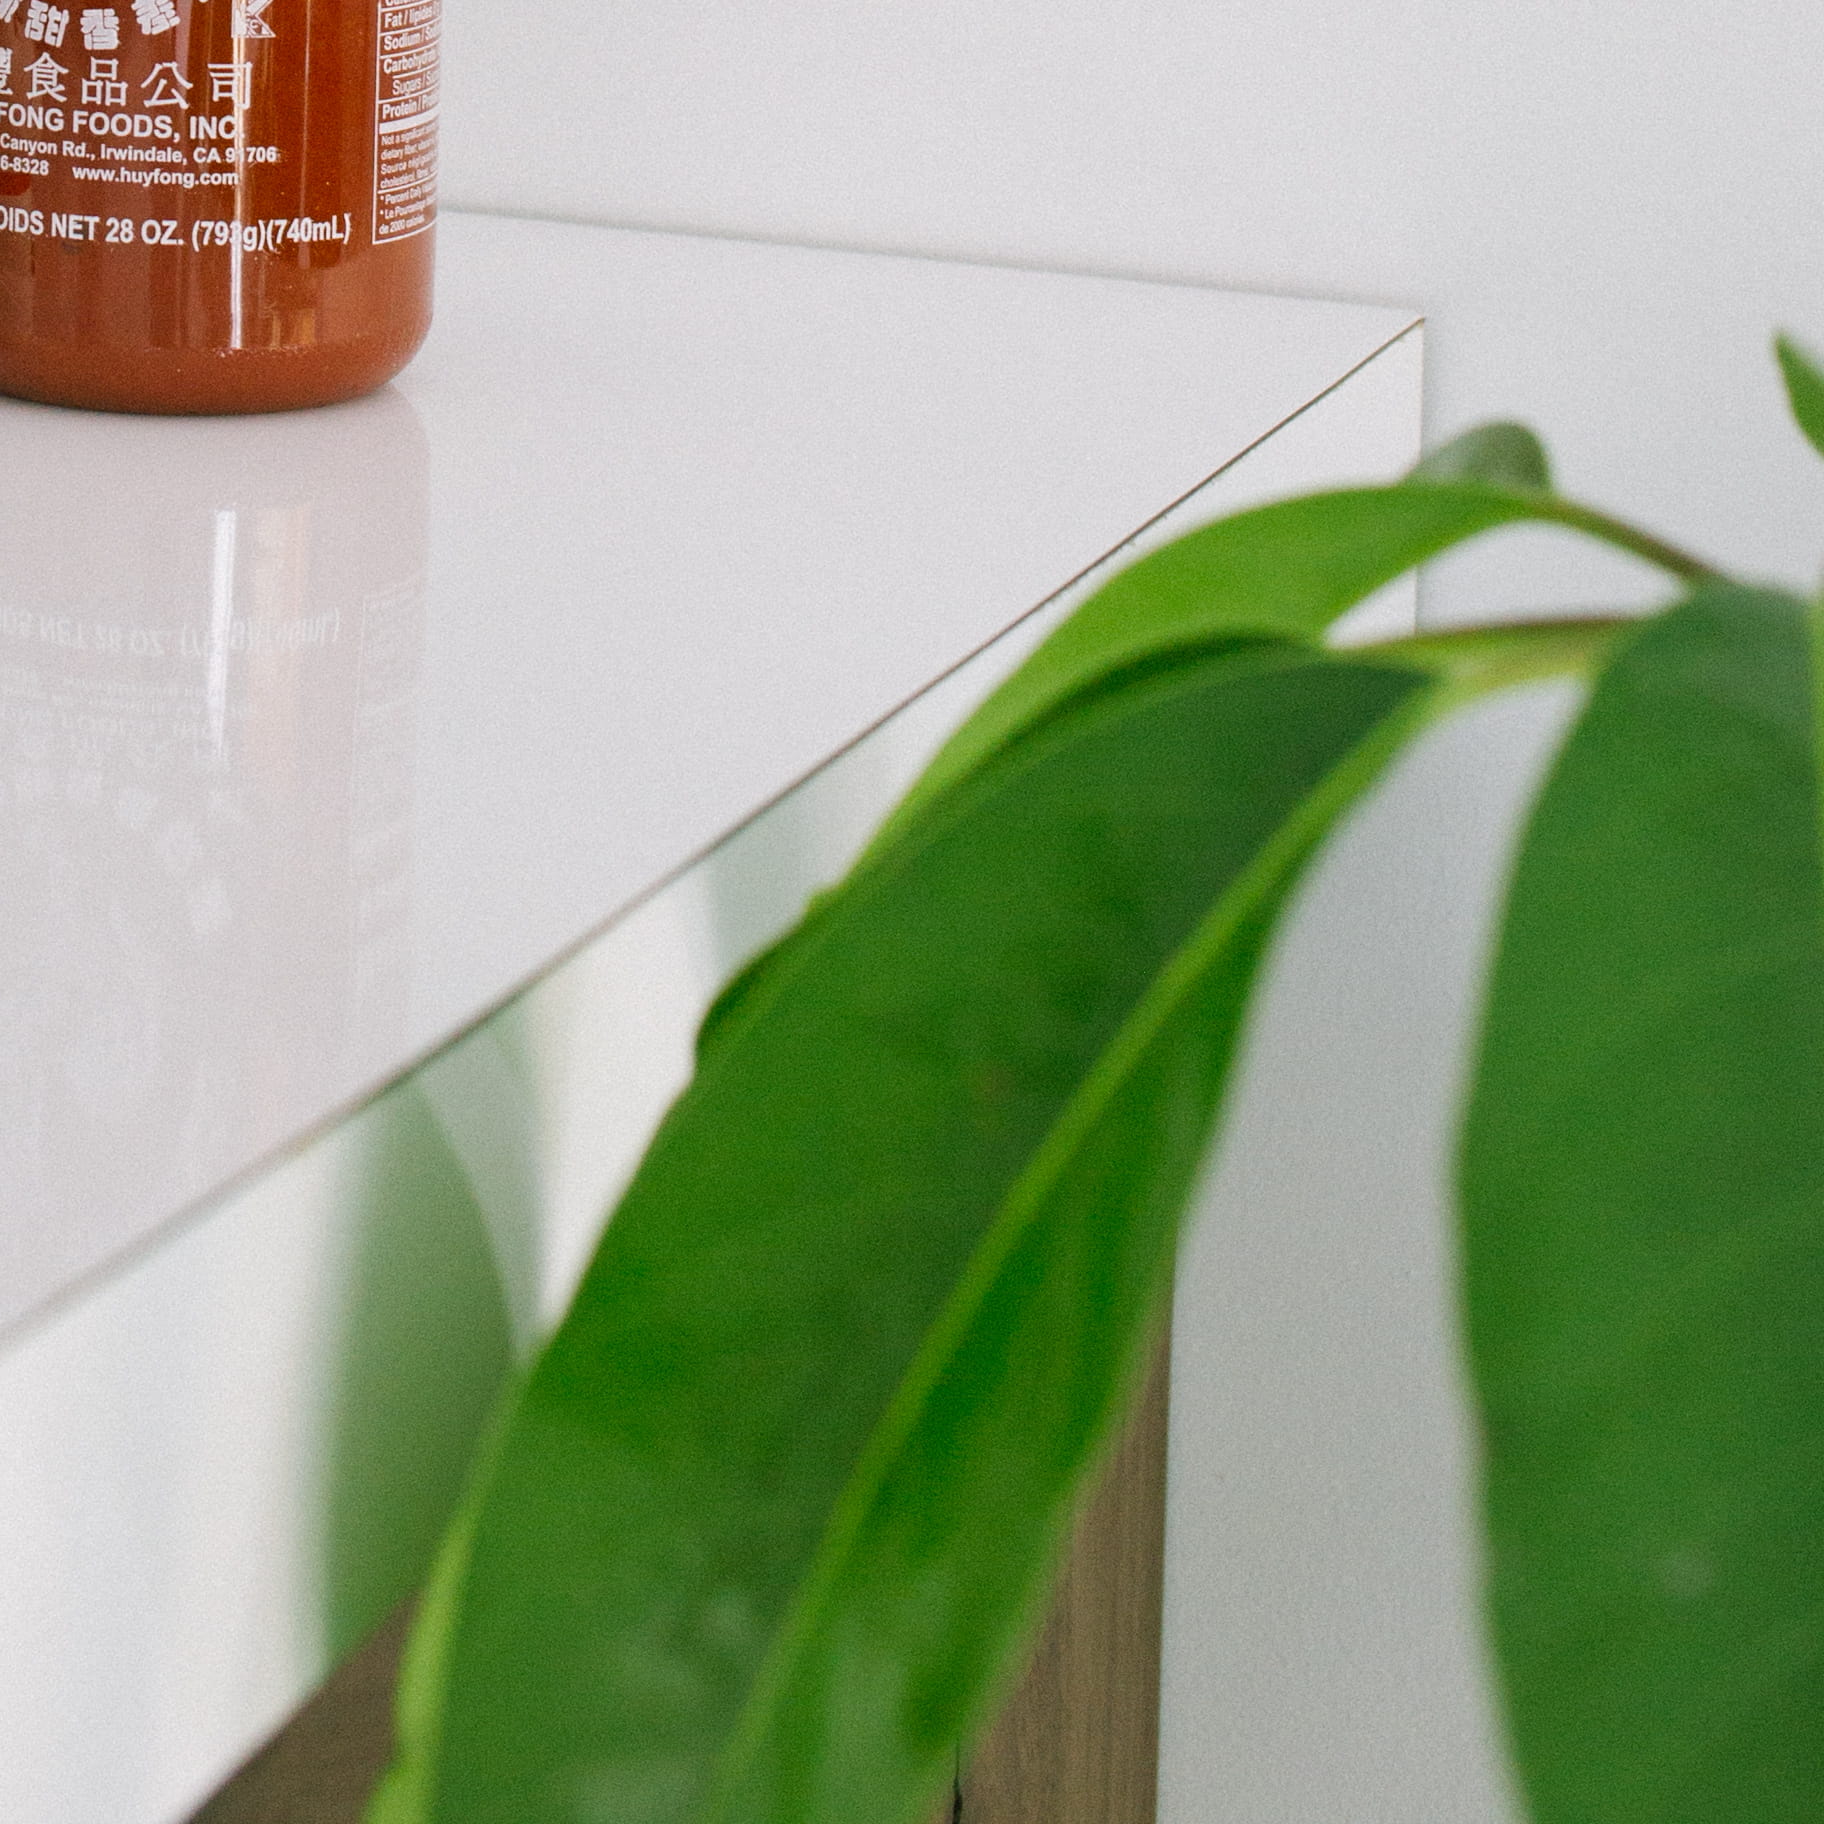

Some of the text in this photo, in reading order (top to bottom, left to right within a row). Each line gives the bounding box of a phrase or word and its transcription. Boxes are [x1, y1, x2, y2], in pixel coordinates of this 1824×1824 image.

[384, 13, 402, 29] Fat
[383, 33, 420, 51] Sodium
[72, 109, 180, 143] FOODS,
[0, 133, 58, 156] Canyon
[62, 140, 96, 161] Rd.,
[100, 143, 188, 165] Irwindale,
[193, 146, 221, 163] CA
[225, 146, 279, 164] 91706
[72, 166, 239, 189] www.huyfong.com
[51, 211, 100, 241] NET
[104, 216, 134, 244] 28
[140, 218, 185, 246] OZ.
